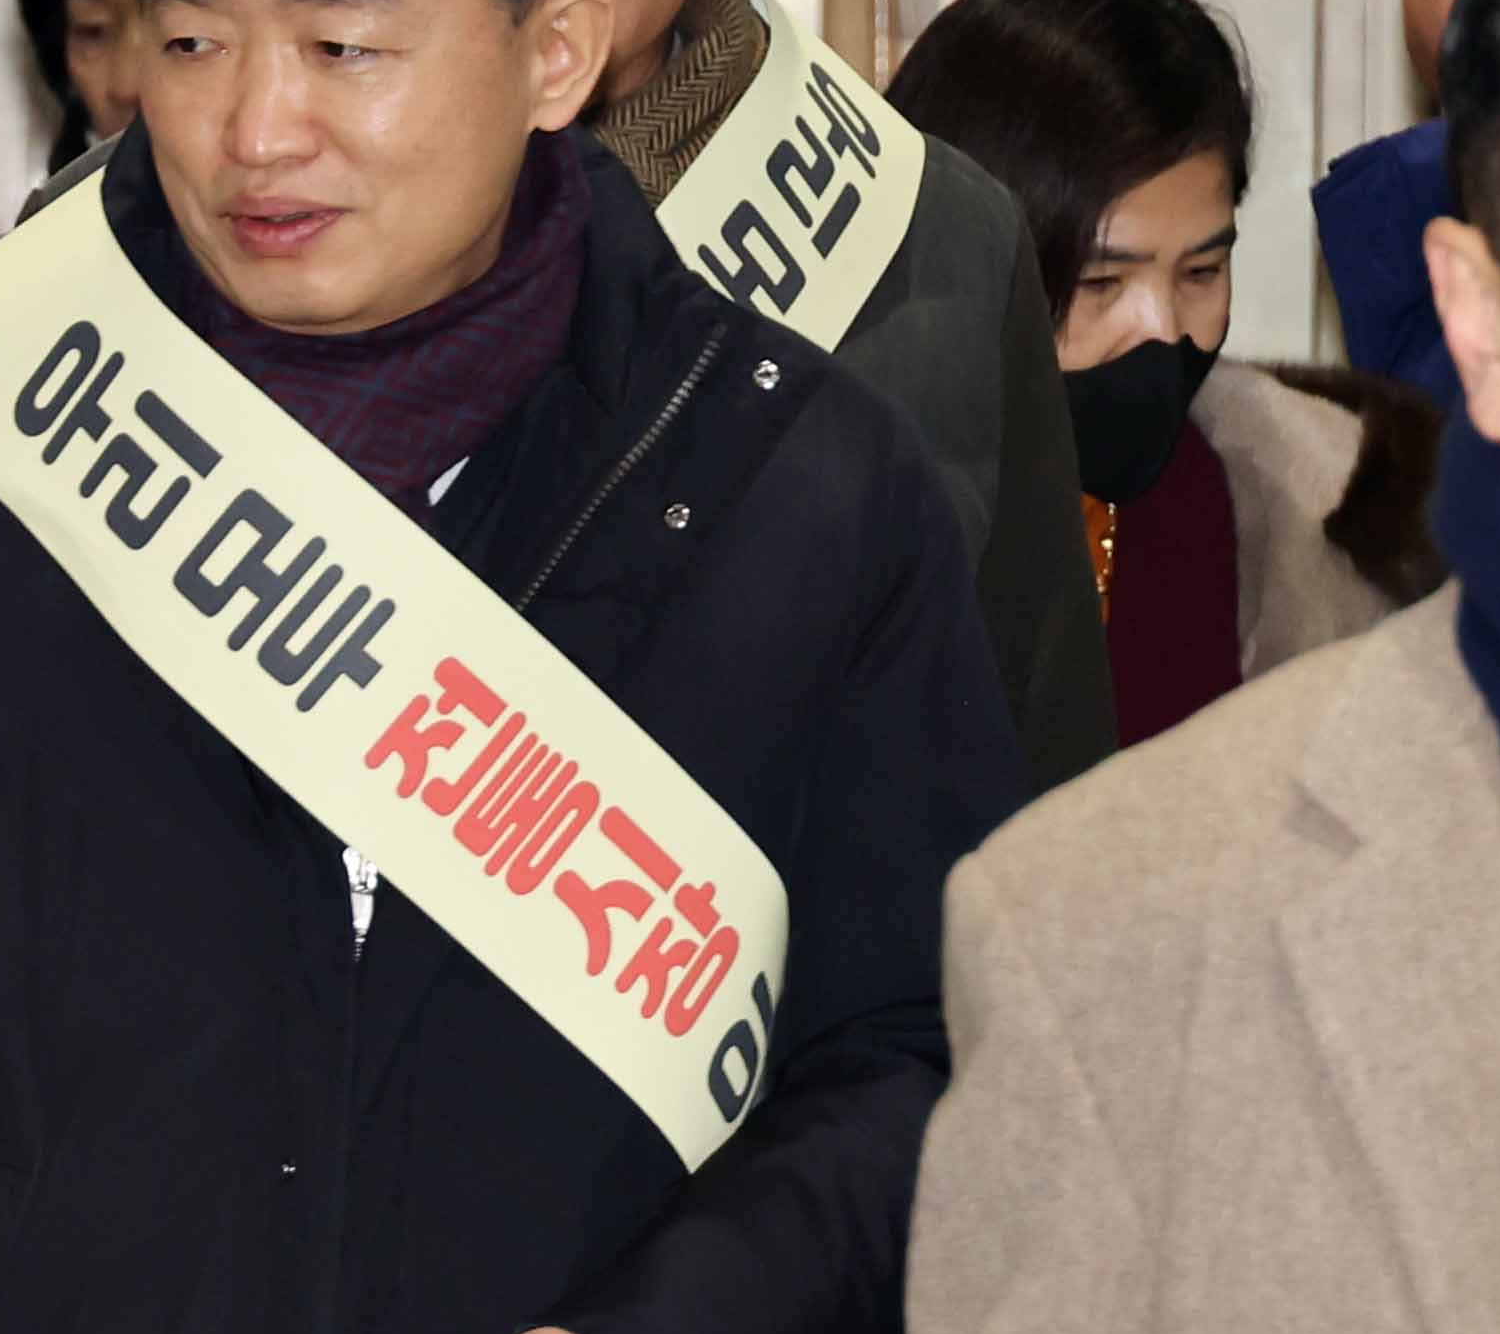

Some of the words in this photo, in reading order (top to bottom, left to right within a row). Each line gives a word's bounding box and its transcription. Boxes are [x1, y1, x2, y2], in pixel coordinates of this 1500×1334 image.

[765, 62, 881, 260] 우리
[13, 319, 224, 552] 우리
[172, 488, 397, 714] 모두
[365, 657, 740, 1037] 전통시장
